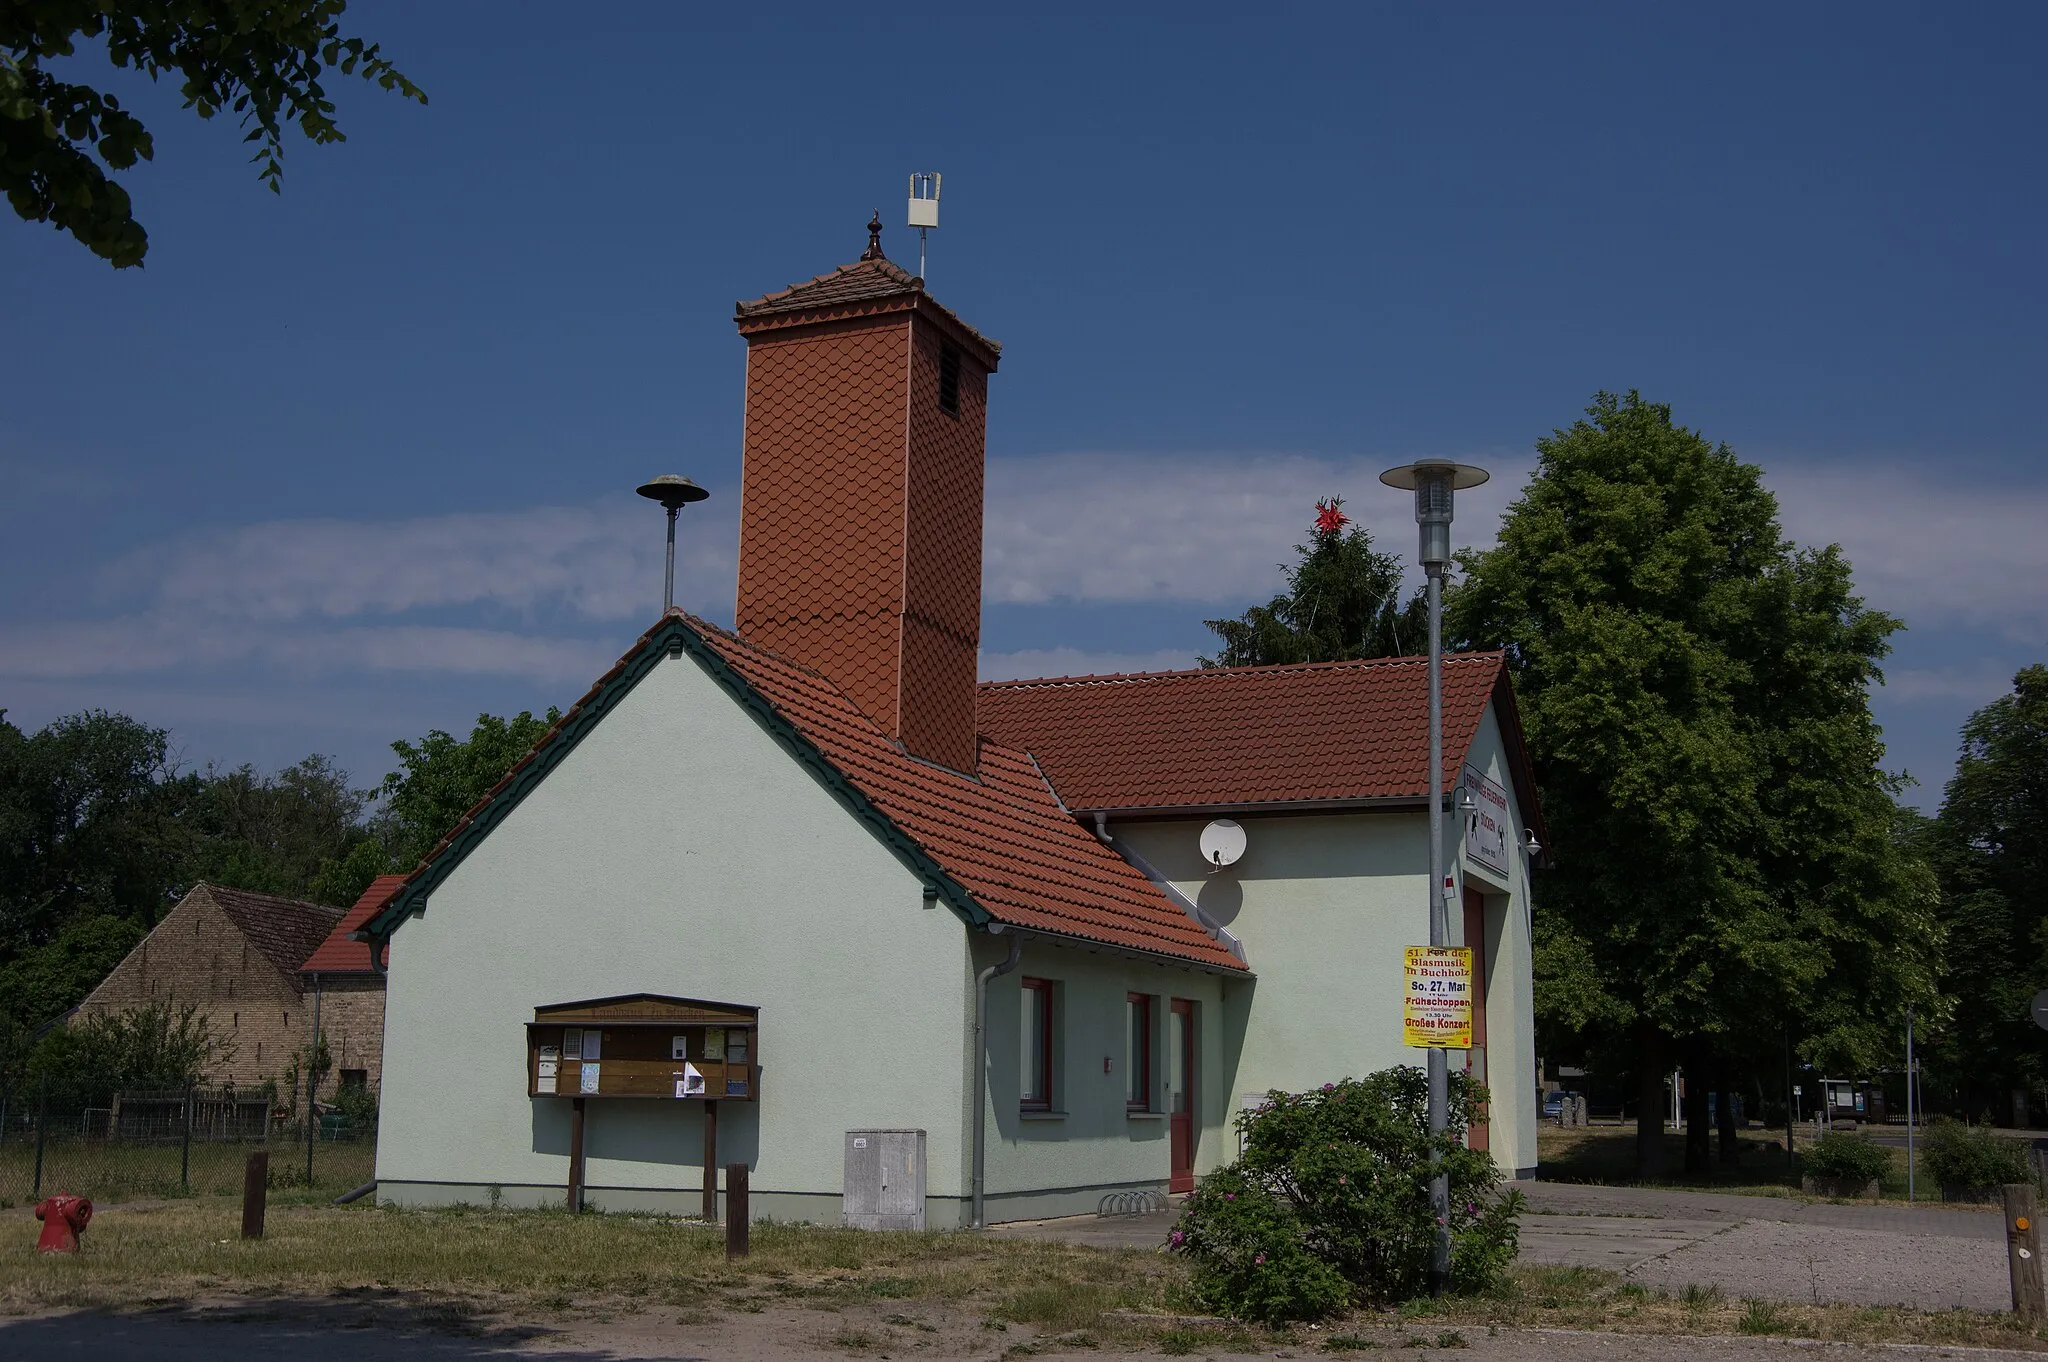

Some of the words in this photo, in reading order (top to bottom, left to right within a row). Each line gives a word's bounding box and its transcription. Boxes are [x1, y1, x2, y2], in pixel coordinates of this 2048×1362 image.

[1407, 949, 1423, 957] 51.
[1451, 948, 1469, 958] der
[1411, 958, 1466, 967] Blasmusik
[1421, 968, 1470, 977] Buchholz
[1411, 981, 1428, 991] So.
[1430, 980, 1445, 992] 27.
[1448, 981, 1466, 992] Mai
[1405, 997, 1471, 1007] Frühschoppen
[1405, 1017, 1435, 1028] Großes
[1437, 1017, 1470, 1029] Konzert
